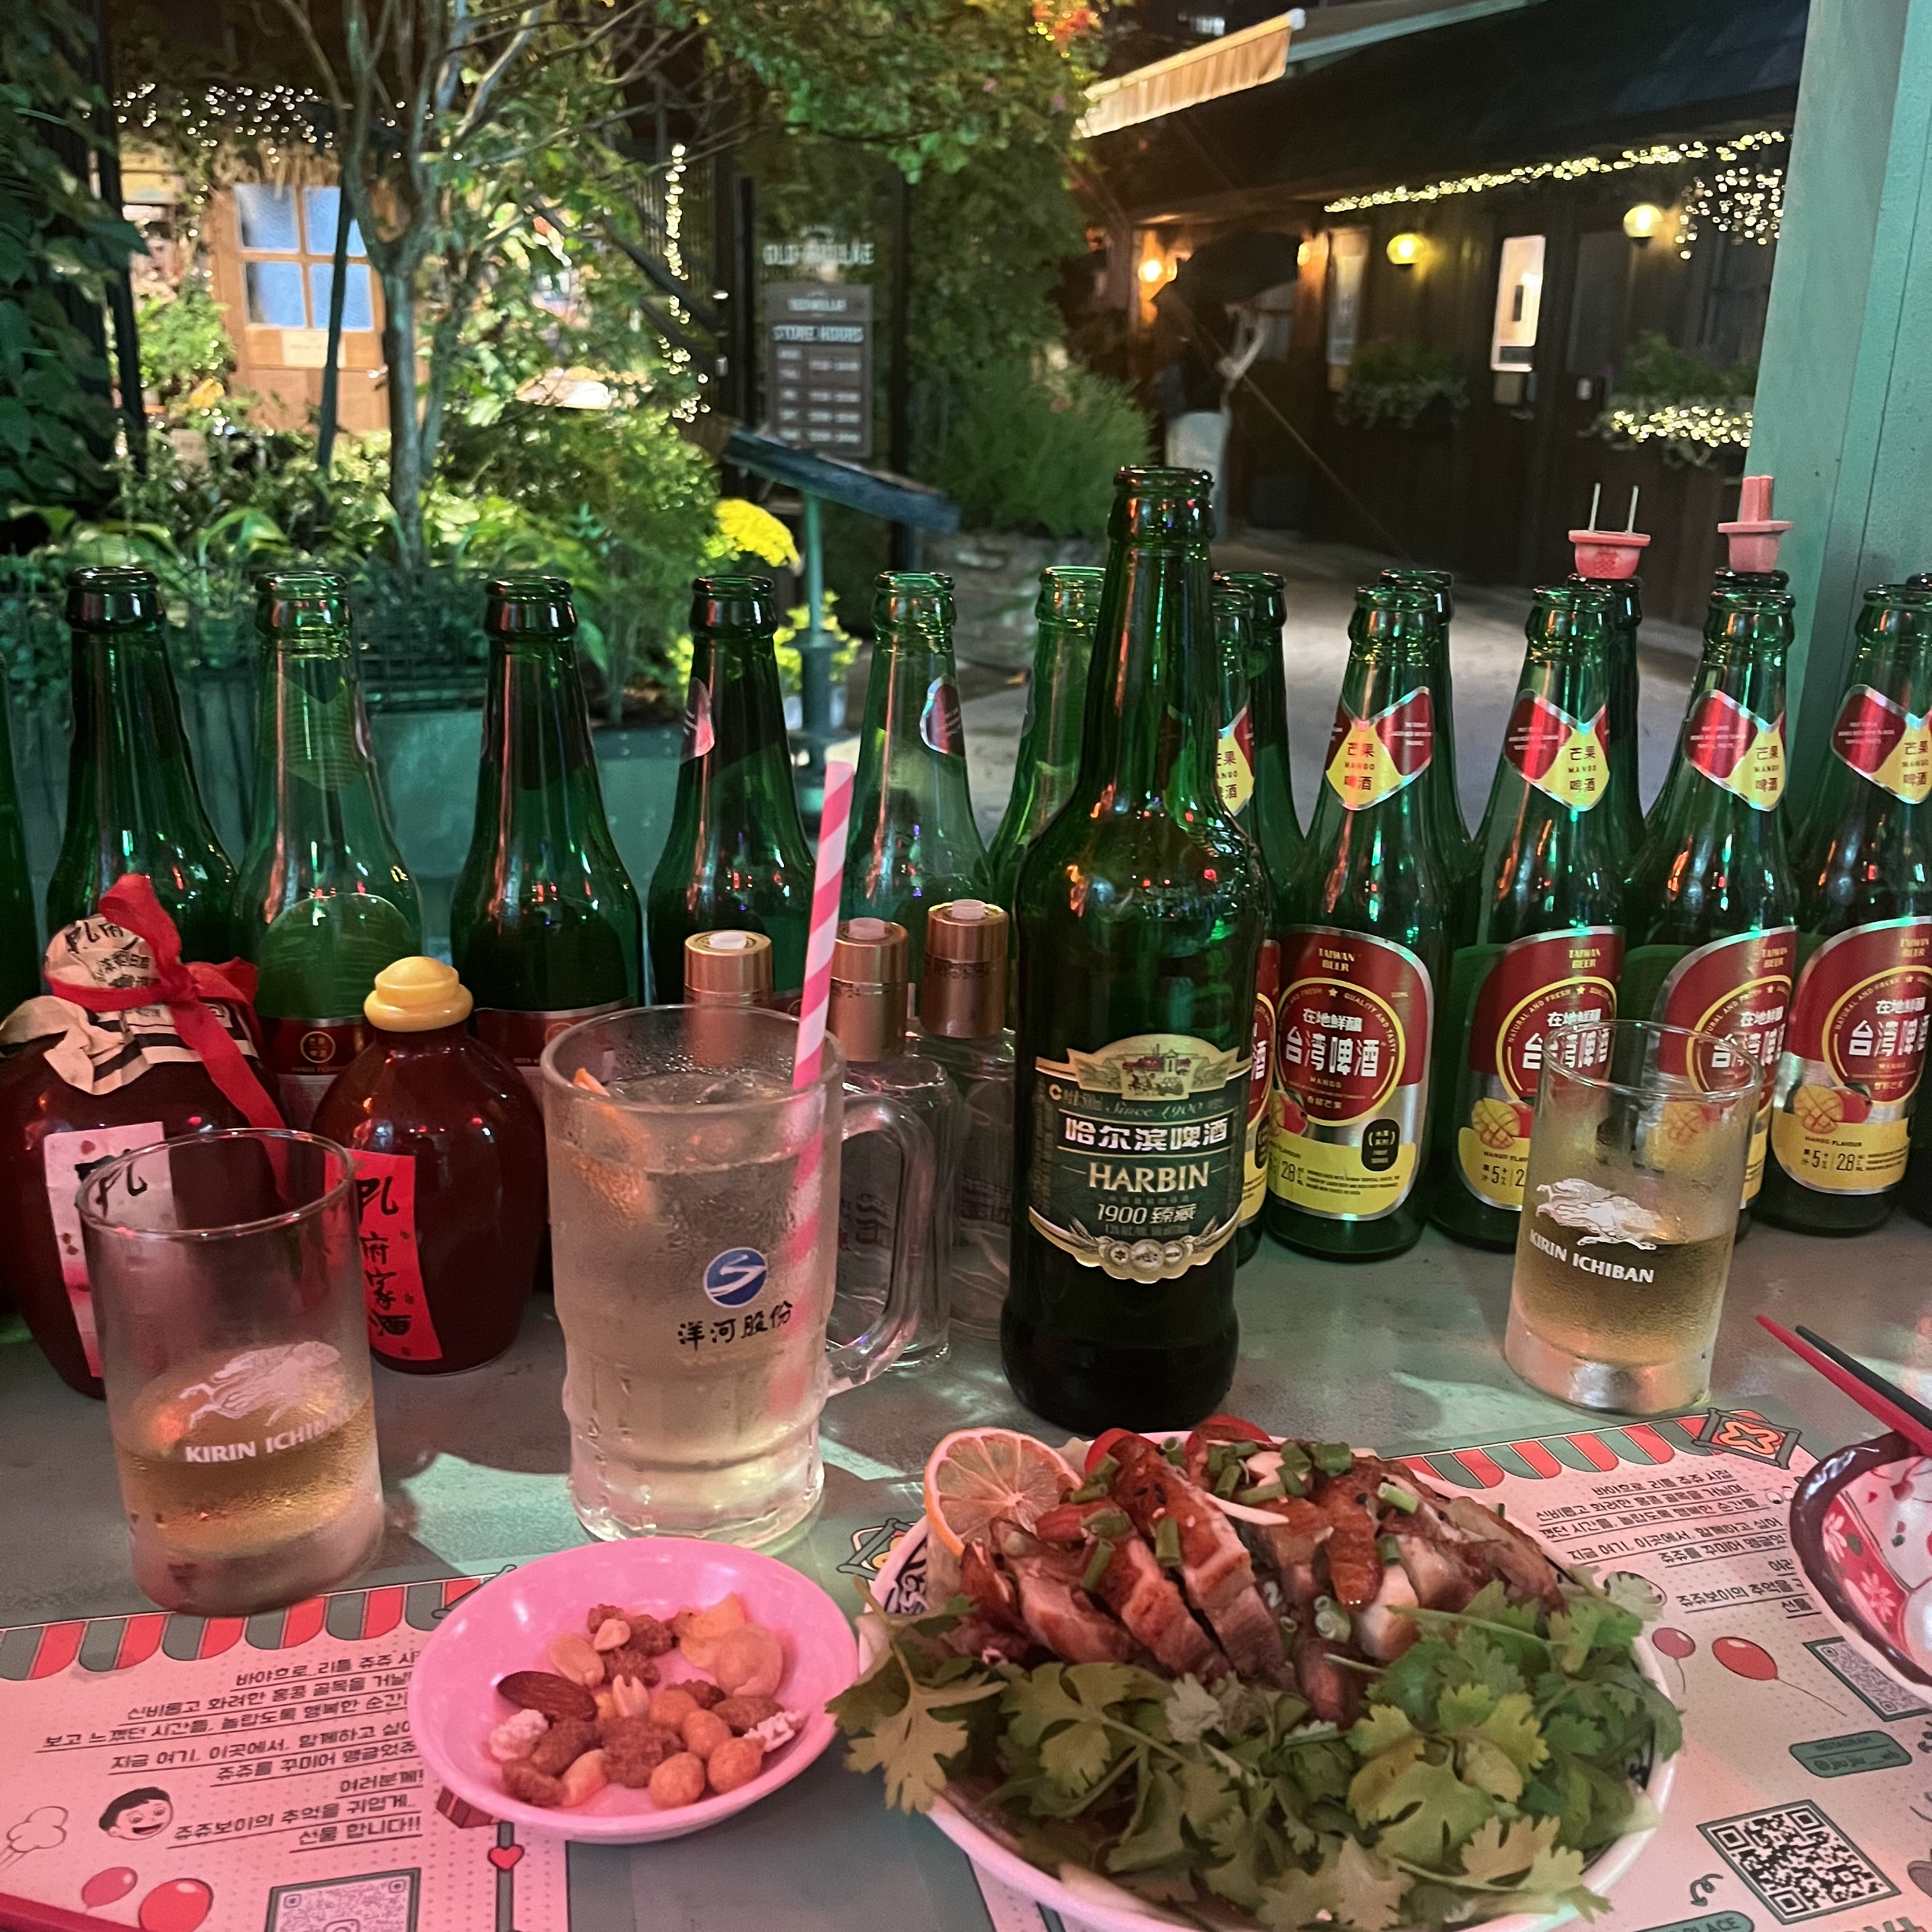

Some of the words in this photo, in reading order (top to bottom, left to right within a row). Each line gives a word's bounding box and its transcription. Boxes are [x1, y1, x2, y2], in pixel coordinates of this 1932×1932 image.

[1347, 742, 1376, 757] 芒果
[1570, 746, 1596, 761] 芒果
[1319, 947, 1355, 962] TAIWAN
[1857, 988, 1874, 1001] AND
[1722, 1000, 1739, 1015] AND
[1508, 1013, 1530, 1043] NATURAL
[1528, 1000, 1545, 1013] AND
[1065, 1117, 1229, 1151] 哈尔滨啤酒
[1280, 1160, 1296, 1182] 28
[1836, 1153, 1855, 1172] 28
[1089, 1161, 1210, 1193] HARBIN
[1097, 1203, 1148, 1225] 1900
[1529, 1229, 1567, 1262] KIRIN
[1572, 1252, 1655, 1284] ICHIBAN
[677, 1300, 793, 1353] 洋河股份
[185, 1440, 256, 1463] KIRIN
[1676, 1473, 1705, 1485] 쥬쥬
[1590, 1498, 1634, 1512] 화려한
[1566, 1547, 1599, 1561] 지금
[1693, 1521, 1754, 1538] 함께하고
[1675, 1586, 1750, 1607] 쥬쥬보이의
[358, 1654, 392, 1669] 쥬쥬
[206, 1691, 266, 1710] 화려한
[43, 1732, 82, 1748] 보고
[365, 1691, 408, 1711] 순간
[111, 1753, 150, 1770] 지금
[298, 1726, 376, 1749] 함께하고
[216, 1760, 273, 1782] 쥬쥬를
[174, 1813, 274, 1841] 쥬쥬보이의
[280, 1802, 340, 1825] 추억을
[298, 1825, 337, 1846] 선물
